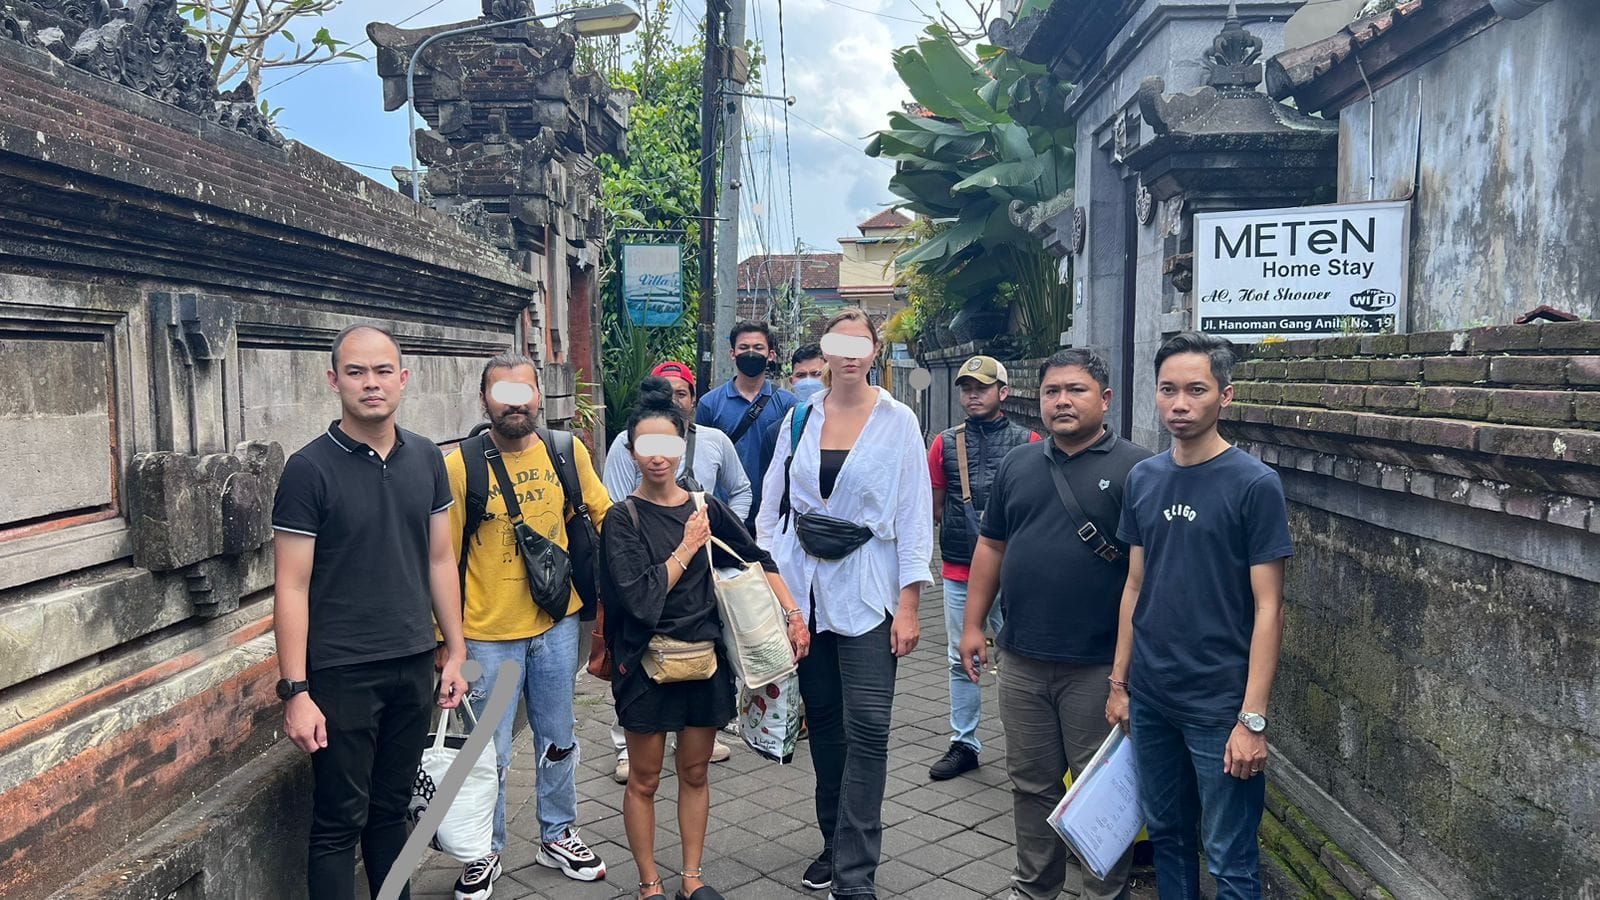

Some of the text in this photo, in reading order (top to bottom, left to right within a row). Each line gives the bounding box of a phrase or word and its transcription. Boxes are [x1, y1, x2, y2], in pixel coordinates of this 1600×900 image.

[1263, 259, 1374, 279] Home Stay
[639, 274, 669, 285] Villa
[1237, 289, 1269, 302] Hot
[1273, 287, 1331, 301] Shower
[1218, 319, 1277, 330] Hanoman
[1279, 318, 1312, 331] Gang
[488, 468, 561, 500] MDE M
[1163, 504, 1197, 522] ELIGO
